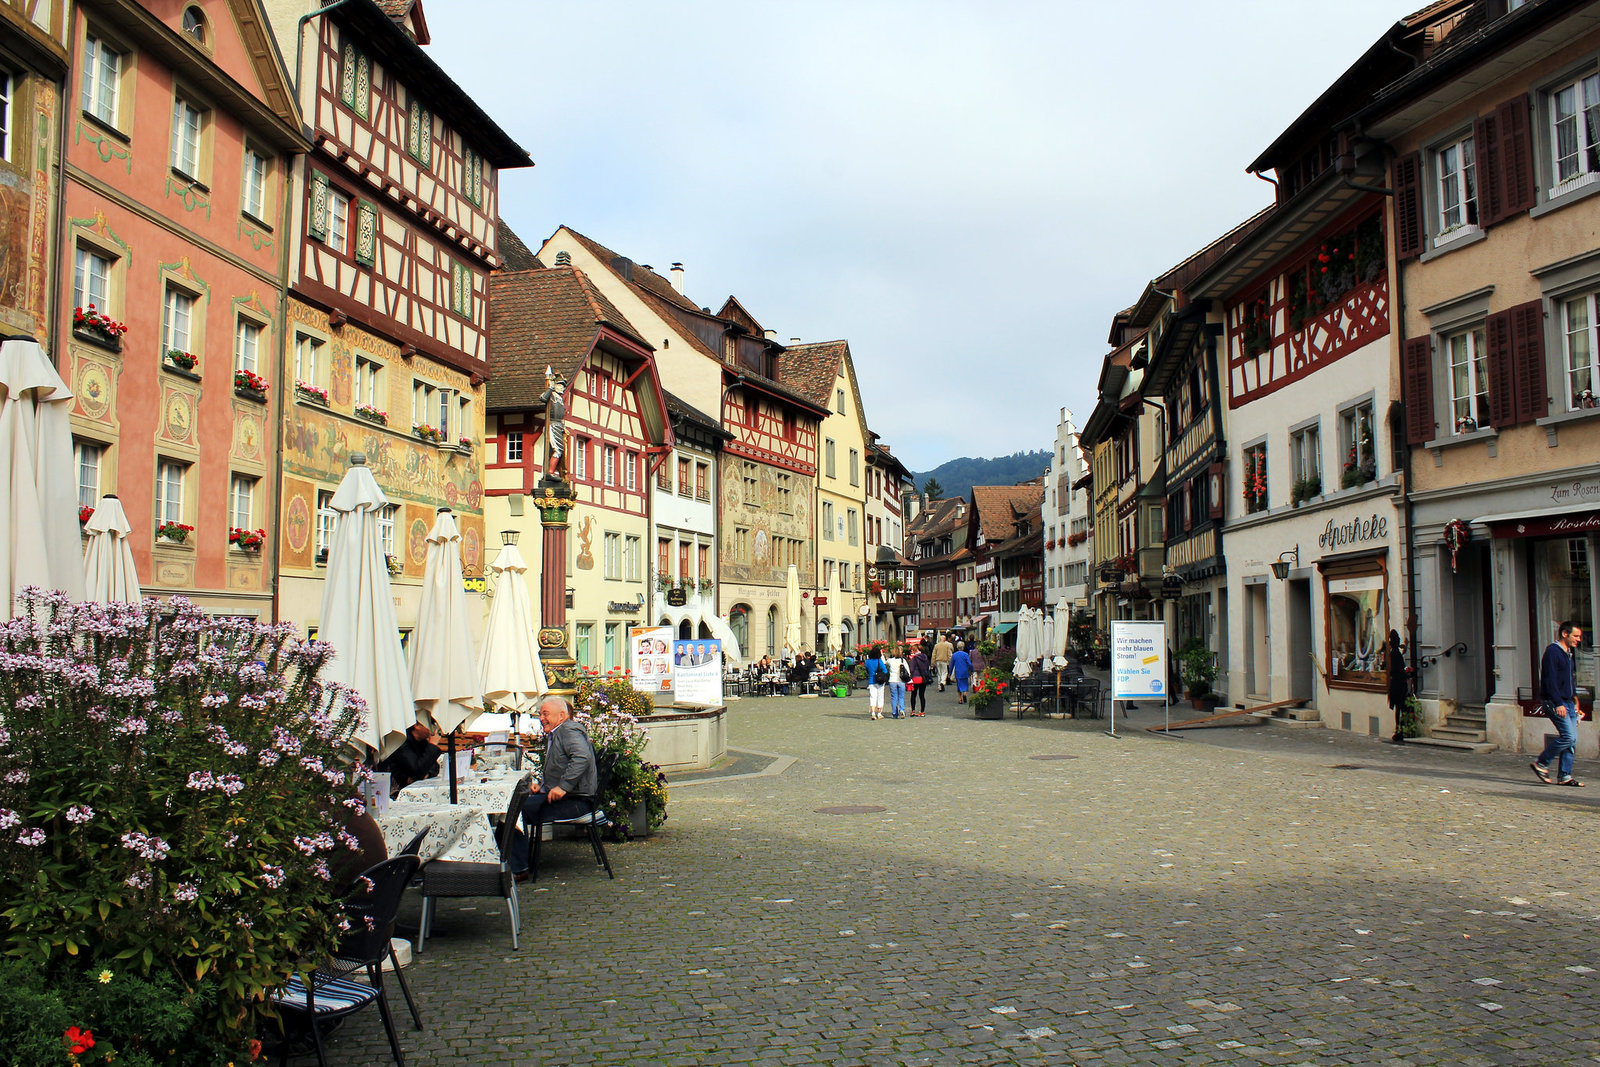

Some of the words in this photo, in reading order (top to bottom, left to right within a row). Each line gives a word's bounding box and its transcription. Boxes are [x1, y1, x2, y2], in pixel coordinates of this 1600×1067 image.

[1550, 485, 1570, 503] Zum
[1573, 482, 1600, 498] Rosen
[1550, 515, 1600, 530] Rosebo
[1318, 514, 1388, 551] Apotheke
[463, 579, 486, 592] olg
